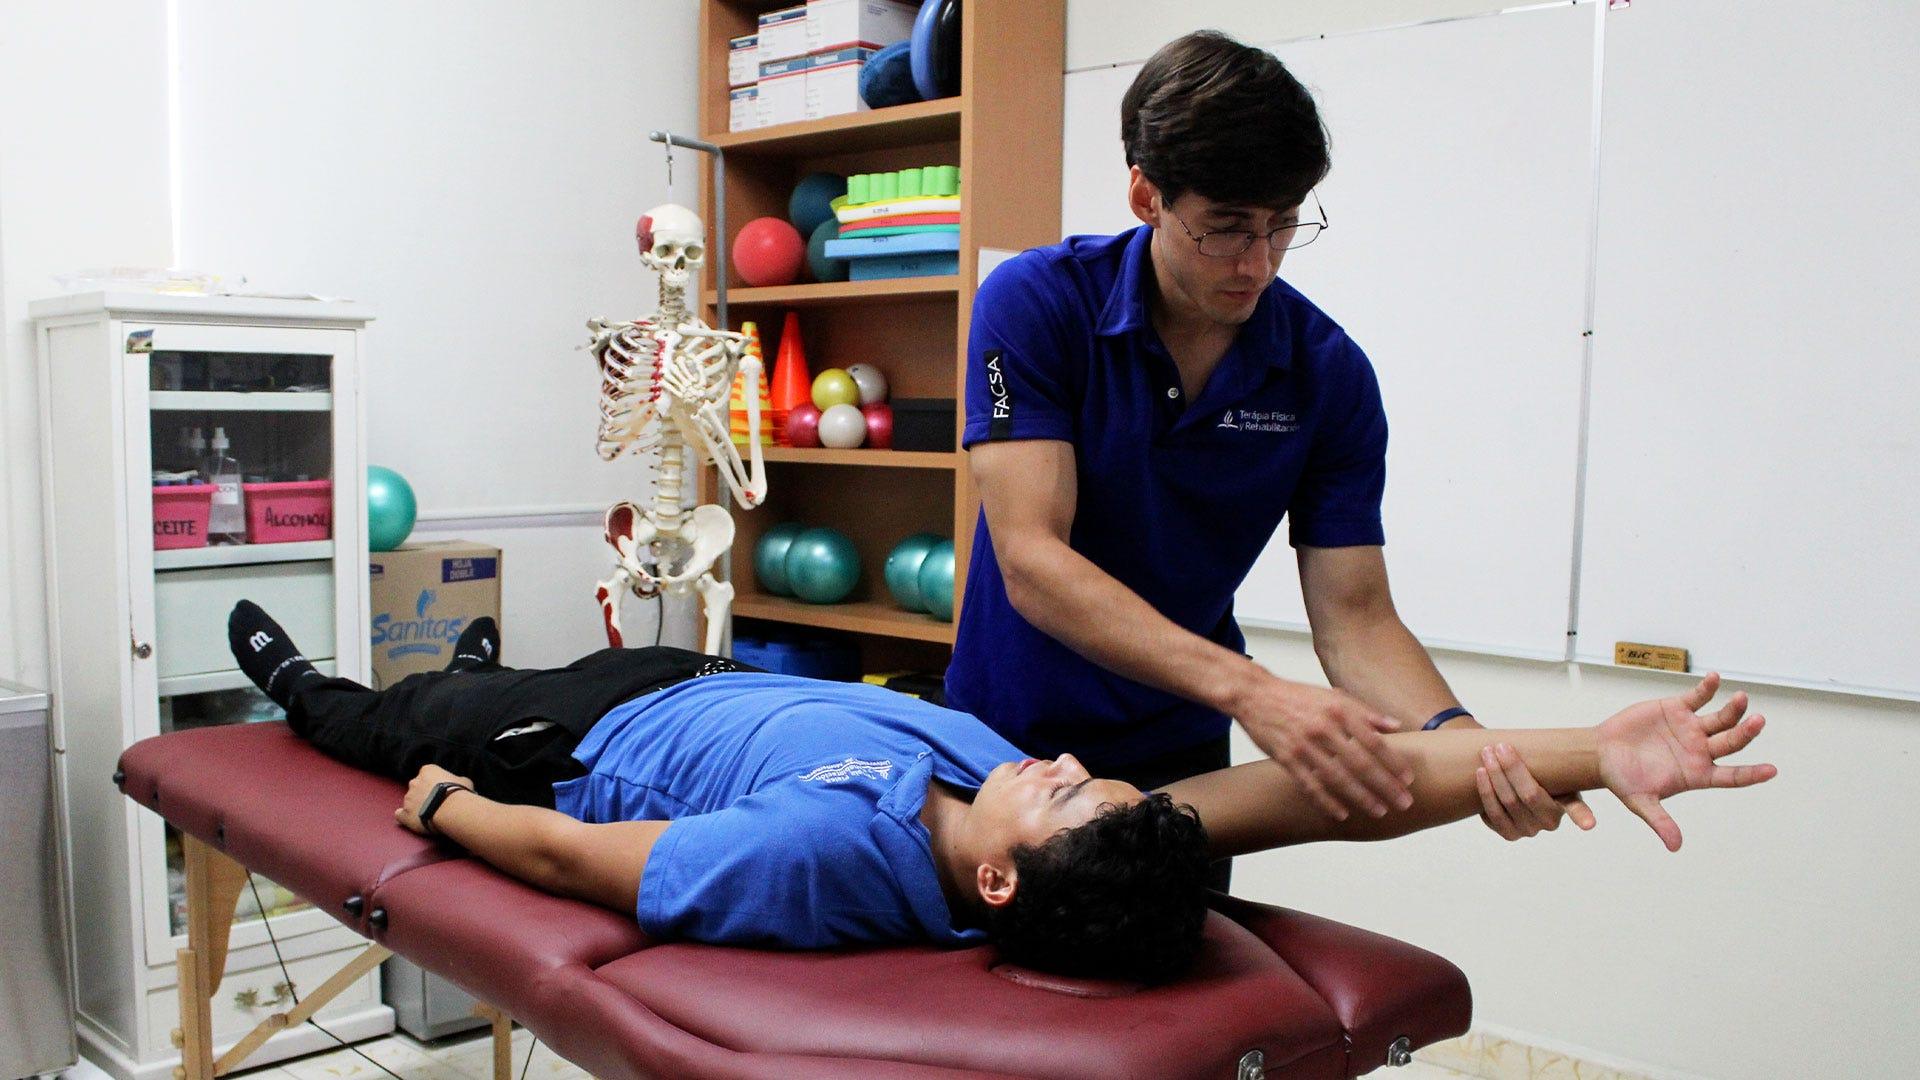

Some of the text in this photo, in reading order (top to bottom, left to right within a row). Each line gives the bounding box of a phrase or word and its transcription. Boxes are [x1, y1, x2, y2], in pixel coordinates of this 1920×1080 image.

[987, 356, 1010, 418] FACSA
[1271, 411, 1296, 421] Física
[371, 613, 462, 645] Sanitas
[1628, 650, 1651, 659] BIC
